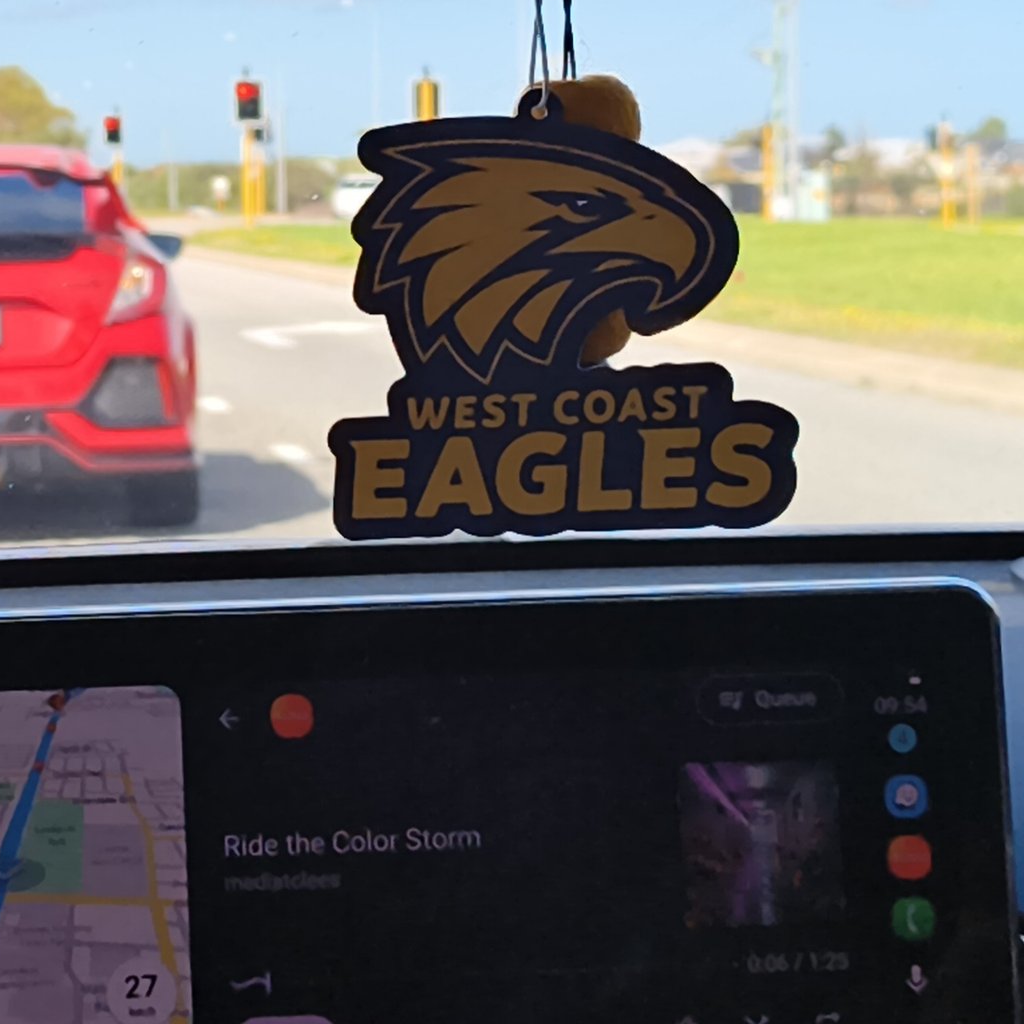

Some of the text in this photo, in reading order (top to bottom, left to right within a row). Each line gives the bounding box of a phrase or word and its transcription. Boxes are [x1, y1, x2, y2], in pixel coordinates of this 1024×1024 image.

[407, 386, 708, 430] WEST COAST
[350, 424, 774, 519] EAGLES
[874, 695, 929, 714] 0954
[224, 827, 481, 857] Ride the Color Storm
[124, 974, 158, 999] 27
